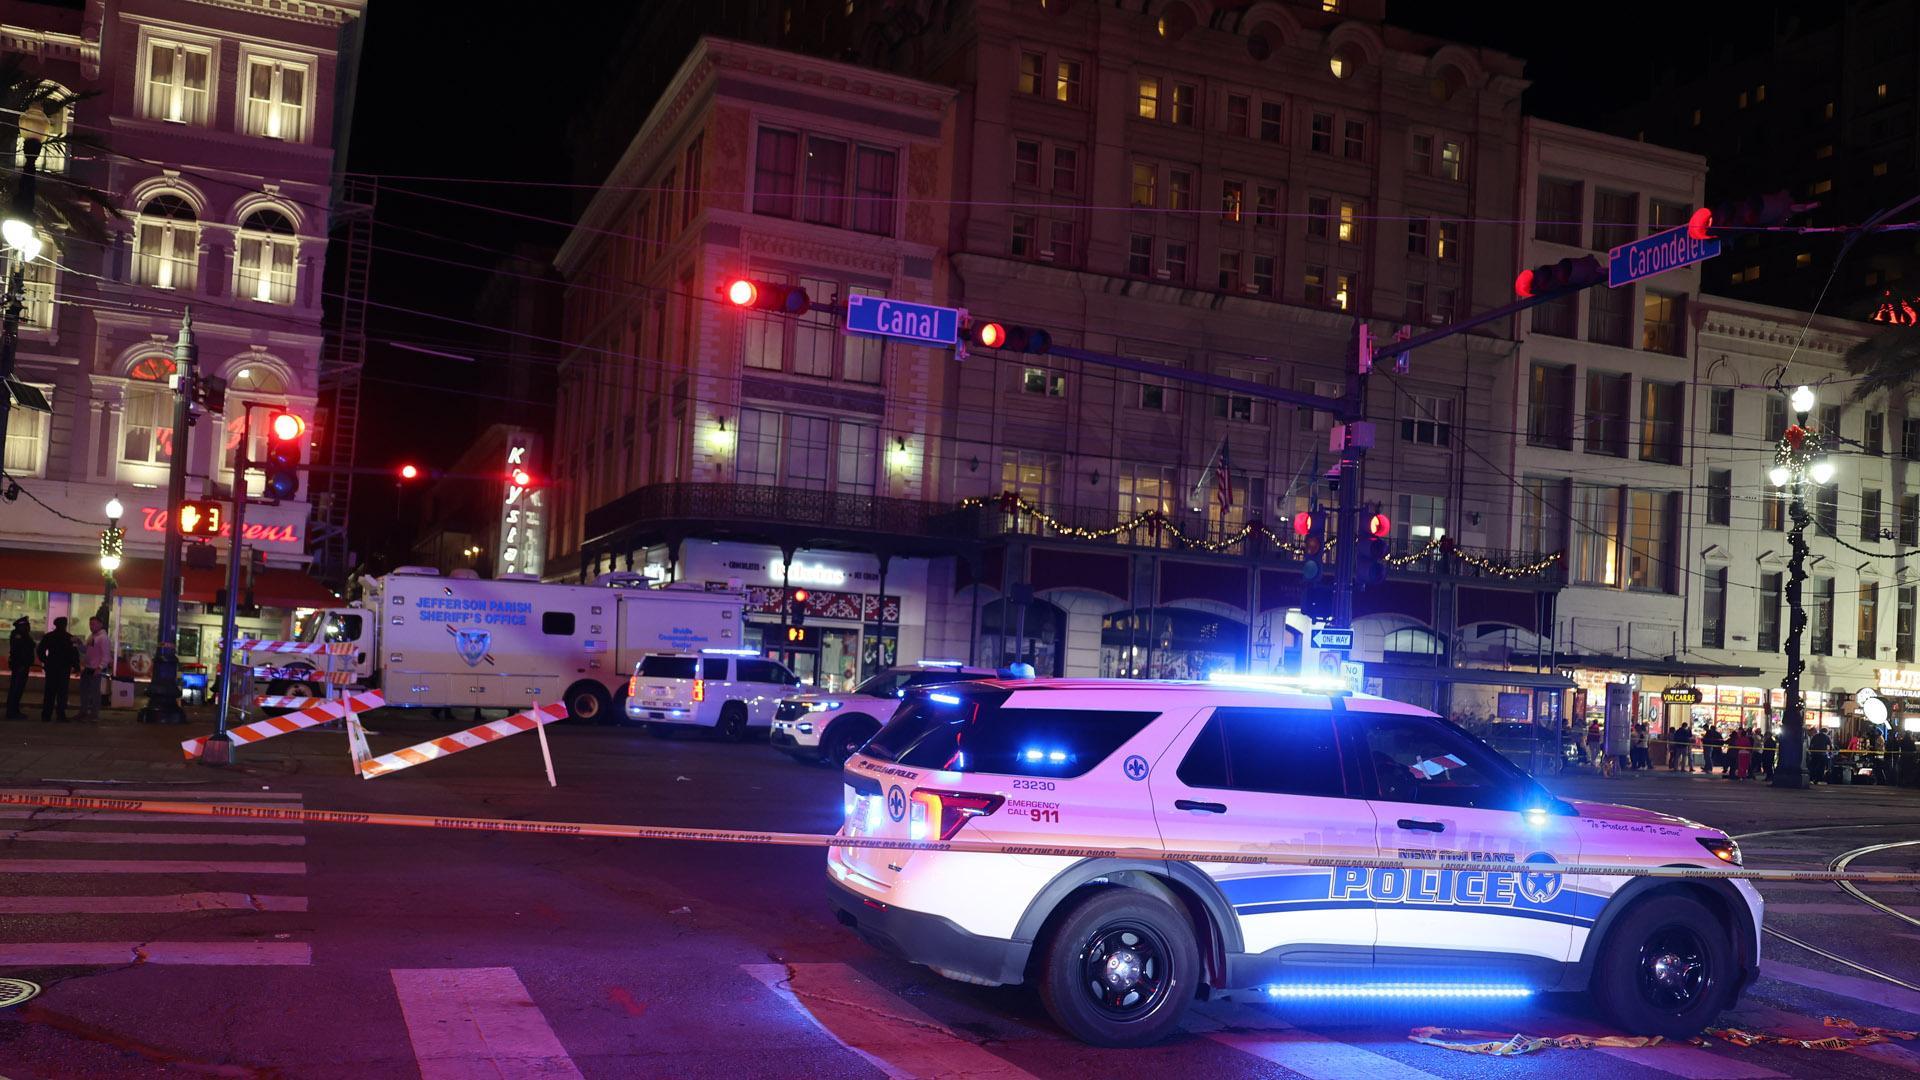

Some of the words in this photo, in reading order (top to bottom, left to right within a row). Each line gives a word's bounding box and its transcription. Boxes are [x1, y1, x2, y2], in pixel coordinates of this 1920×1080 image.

[1629, 231, 1706, 278] Carondelet
[877, 302, 939, 338] Canal
[208, 507, 219, 532] 3
[416, 597, 487, 611] JEFFERSON
[490, 600, 532, 613] PARISH
[420, 610, 482, 623] SHERIFF'S
[485, 614, 526, 625] OFFICE
[1322, 635, 1335, 643] ONE
[1345, 665, 1358, 675] NO
[1013, 779, 1055, 791] 23230
[1007, 800, 1060, 810] EMERGENCY
[1007, 808, 1028, 816] CALL
[1030, 808, 1059, 823] 911
[1600, 821, 1628, 831] Protect
[1631, 824, 1645, 832] and
[1646, 825, 1656, 833] To
[1398, 848, 1436, 860] NEW
[1438, 851, 1516, 863] ORLEANS
[1329, 865, 1518, 906] POLICE
